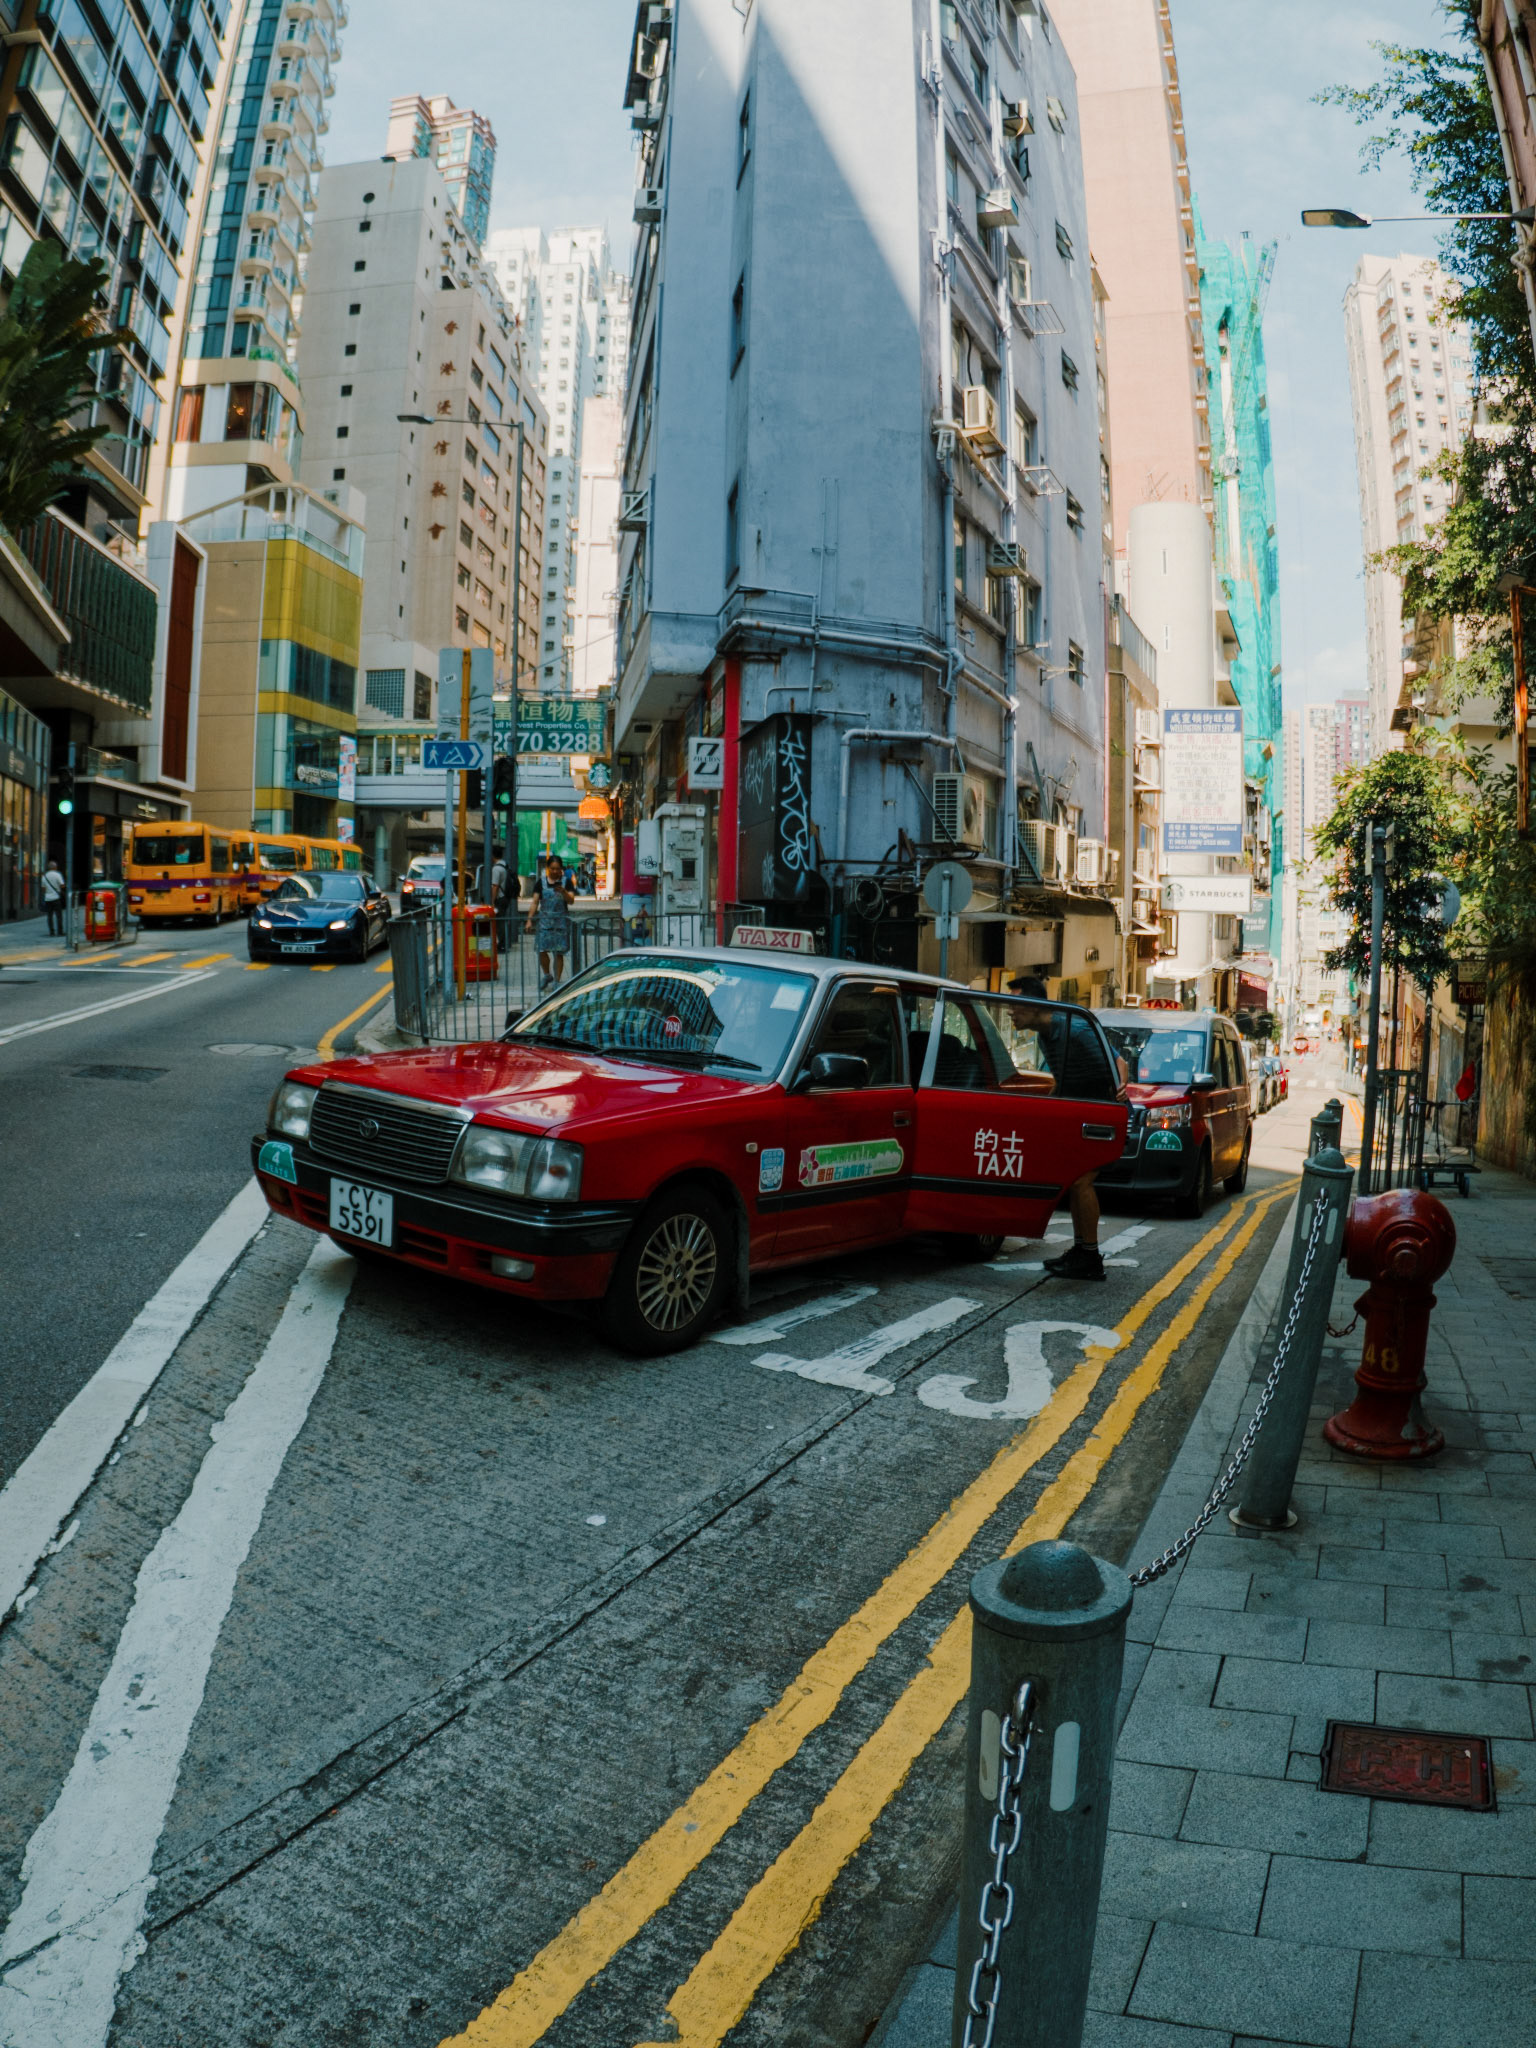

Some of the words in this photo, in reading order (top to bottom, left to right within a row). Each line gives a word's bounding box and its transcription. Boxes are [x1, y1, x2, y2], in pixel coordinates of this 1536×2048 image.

[535, 722, 572, 730] Properties
[547, 732, 601, 753] 3288
[1189, 890, 1244, 898] STARBUCKS
[738, 928, 801, 948] TAXI
[1147, 999, 1179, 1009] TAXI
[665, 1020, 680, 1033] TAXI
[974, 1127, 1024, 1154] 的士
[1161, 1136, 1169, 1144] 4
[272, 1151, 281, 1164] 4
[973, 1151, 1024, 1178] TAXI
[265, 1162, 288, 1178] SEATS
[349, 1185, 374, 1213] CY
[338, 1205, 384, 1242] 5591
[1364, 1343, 1400, 1373] 48
